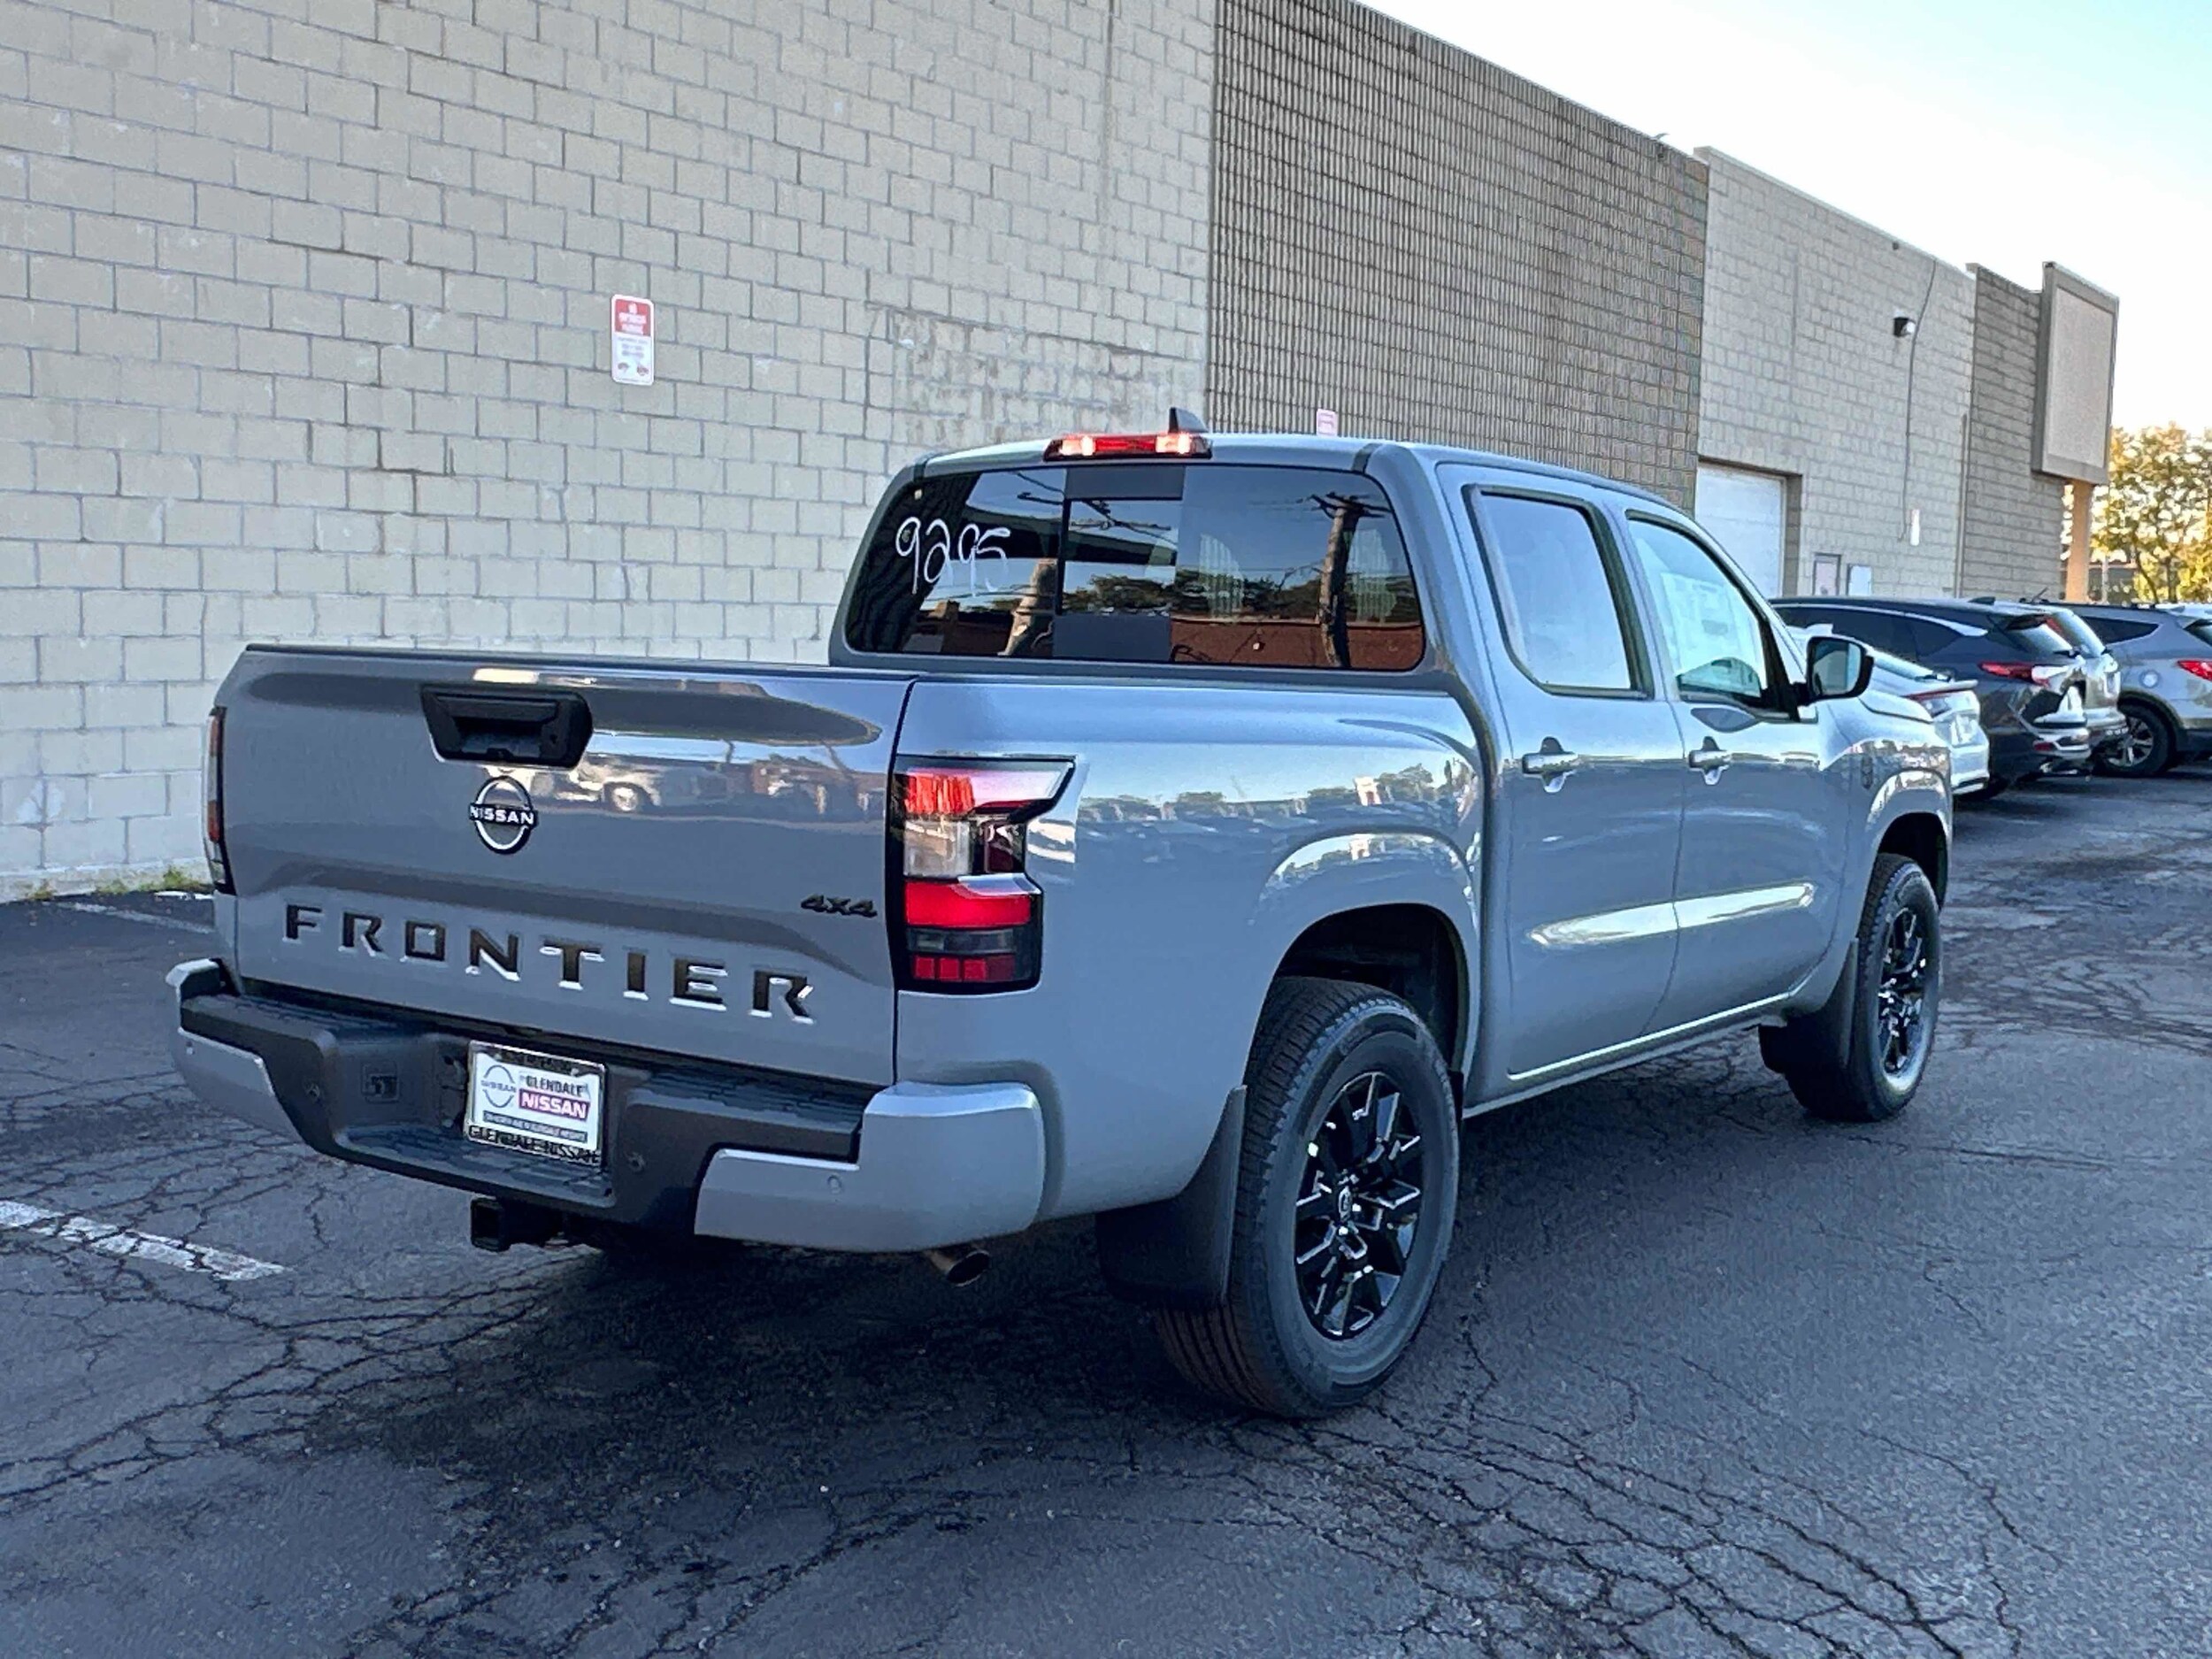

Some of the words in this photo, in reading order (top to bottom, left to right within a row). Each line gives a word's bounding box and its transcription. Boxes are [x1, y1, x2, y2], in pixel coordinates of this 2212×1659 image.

[470, 805, 534, 825] NISSAN
[282, 903, 815, 1025] FRONTIER
[526, 1074, 584, 1098] GLENDALE
[520, 1092, 588, 1120] NISSAN
